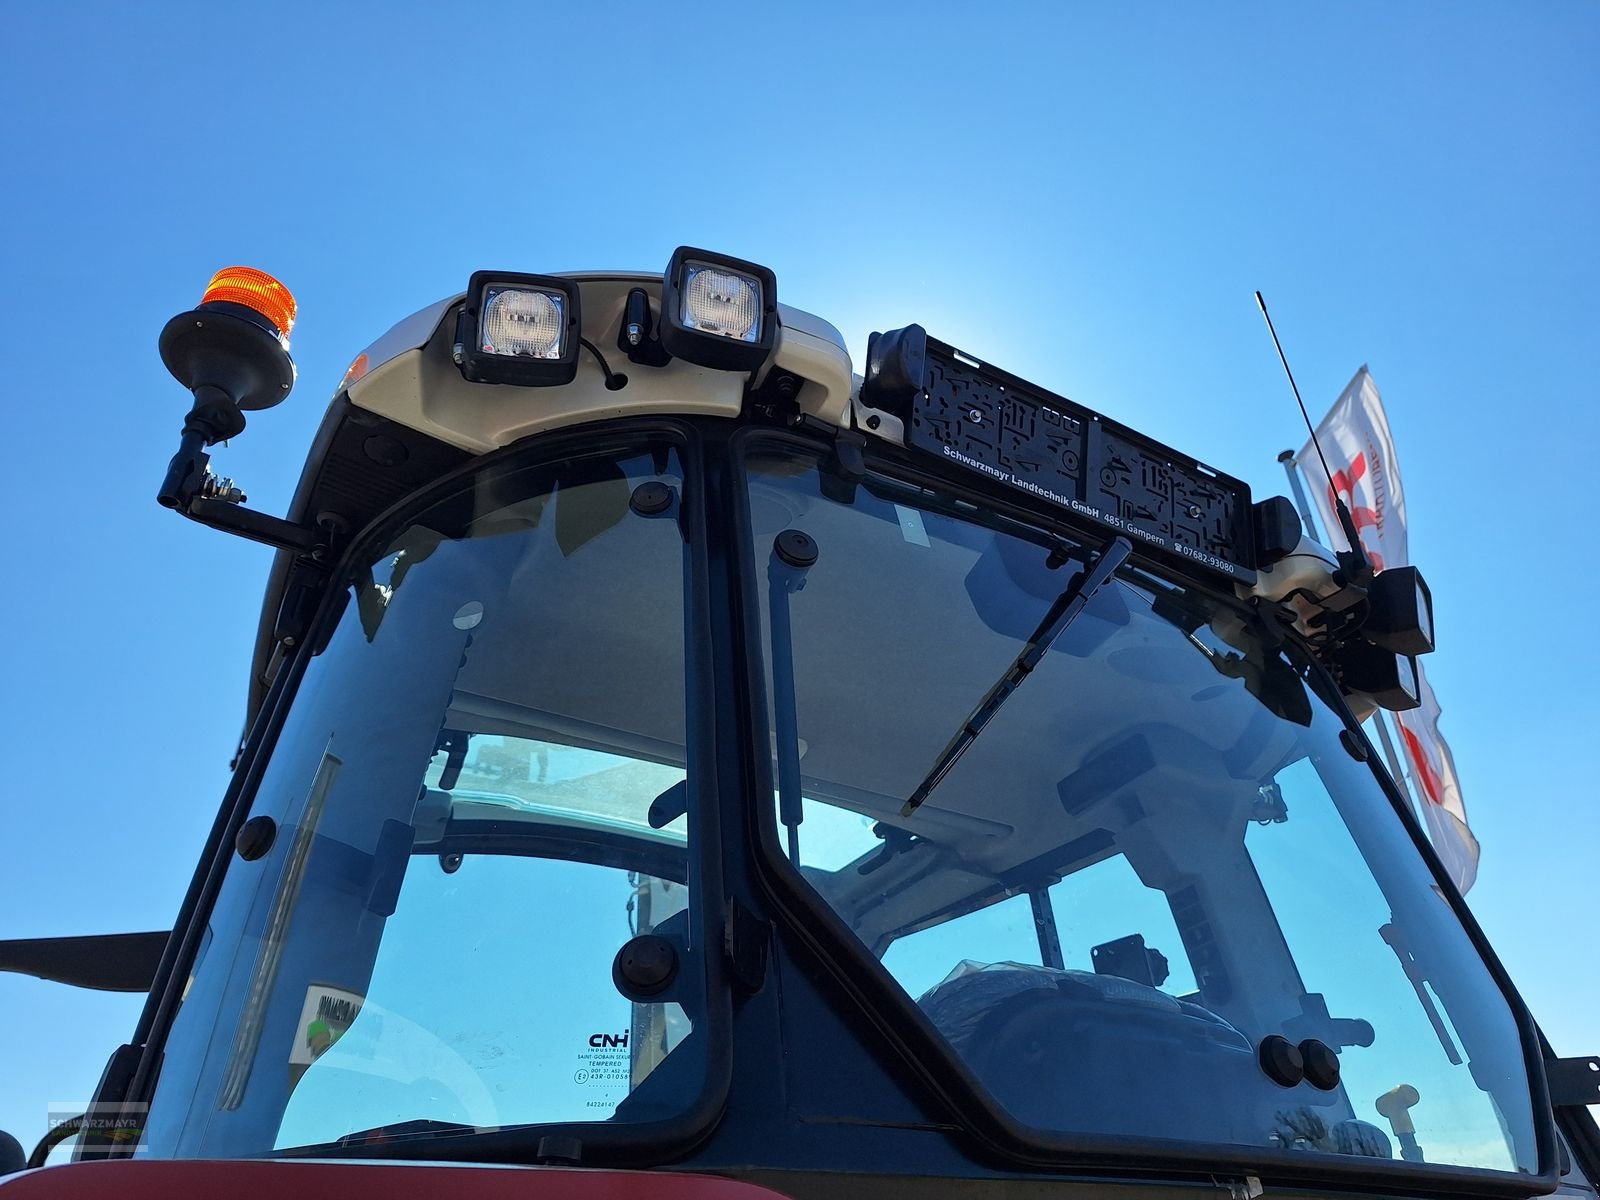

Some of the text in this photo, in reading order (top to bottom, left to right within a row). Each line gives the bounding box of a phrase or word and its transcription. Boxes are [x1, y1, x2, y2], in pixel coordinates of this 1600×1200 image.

[943, 445, 1010, 482] Schwarzmayr
[1011, 474, 1069, 507] Landtechnik
[1071, 499, 1100, 518] GmbH
[1103, 513, 1125, 529] 4851
[1127, 522, 1165, 545] Gampern
